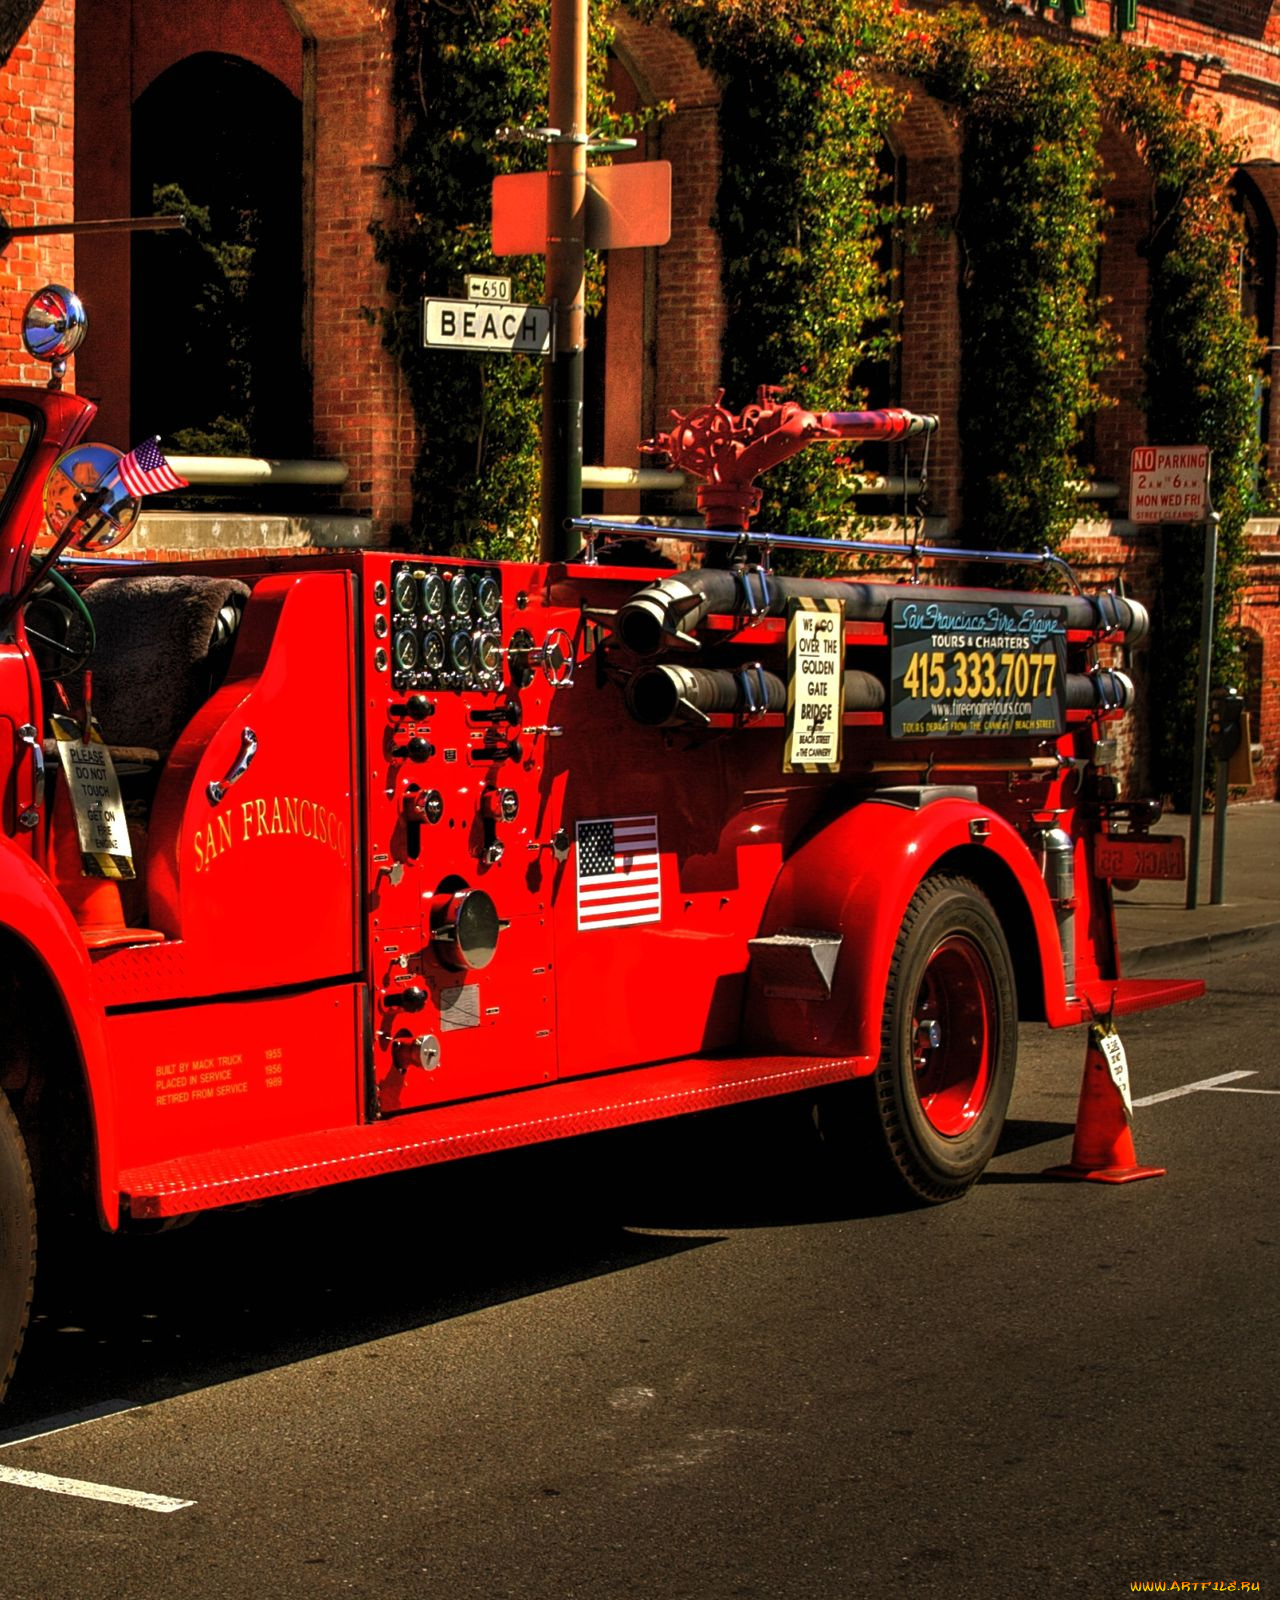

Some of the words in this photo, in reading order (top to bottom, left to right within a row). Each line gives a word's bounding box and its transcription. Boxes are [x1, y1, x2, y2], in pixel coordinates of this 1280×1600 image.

[482, 281, 506, 298] 650
[441, 310, 536, 342] BEACH
[1133, 450, 1154, 470] NO
[1158, 455, 1205, 469] PARKING
[1138, 475, 1147, 489] 2
[1173, 474, 1181, 488] 6
[1136, 495, 1158, 506] MON
[1160, 494, 1182, 506] WED
[1184, 494, 1200, 506] FRI
[803, 619, 813, 631] WE
[896, 604, 925, 629] San
[923, 604, 986, 629] Francisco
[984, 607, 1017, 632] Fire
[1018, 609, 1065, 644] Engine
[799, 639, 820, 653] OVER
[824, 640, 837, 654] THE
[931, 635, 965, 648] TOURS
[975, 636, 1030, 649] CHARTERS
[802, 660, 834, 675] GOLDEN
[903, 652, 1057, 698] 415.333.7077
[808, 682, 827, 696] GATE
[801, 703, 832, 720] BRIDGE
[71, 749, 105, 763] PLEASE
[76, 767, 89, 779] DO
[90, 768, 107, 780] NOT
[82, 784, 110, 797] TOUCH
[87, 810, 102, 821] GET
[104, 810, 115, 822] ON
[194, 810, 232, 872] SAN
[241, 796, 347, 859] FRANCISCO
[156, 1064, 176, 1076] BUILT
[179, 1062, 189, 1073] BY
[192, 1057, 214, 1070] MACK
[218, 1054, 242, 1066] TRUCK
[156, 1076, 187, 1090] PLACED
[190, 1075, 197, 1085] IN
[200, 1069, 232, 1083] SERVICE
[156, 1092, 189, 1106] RETIRED
[192, 1088, 214, 1100] FROM
[216, 1082, 248, 1097] SERVICE
